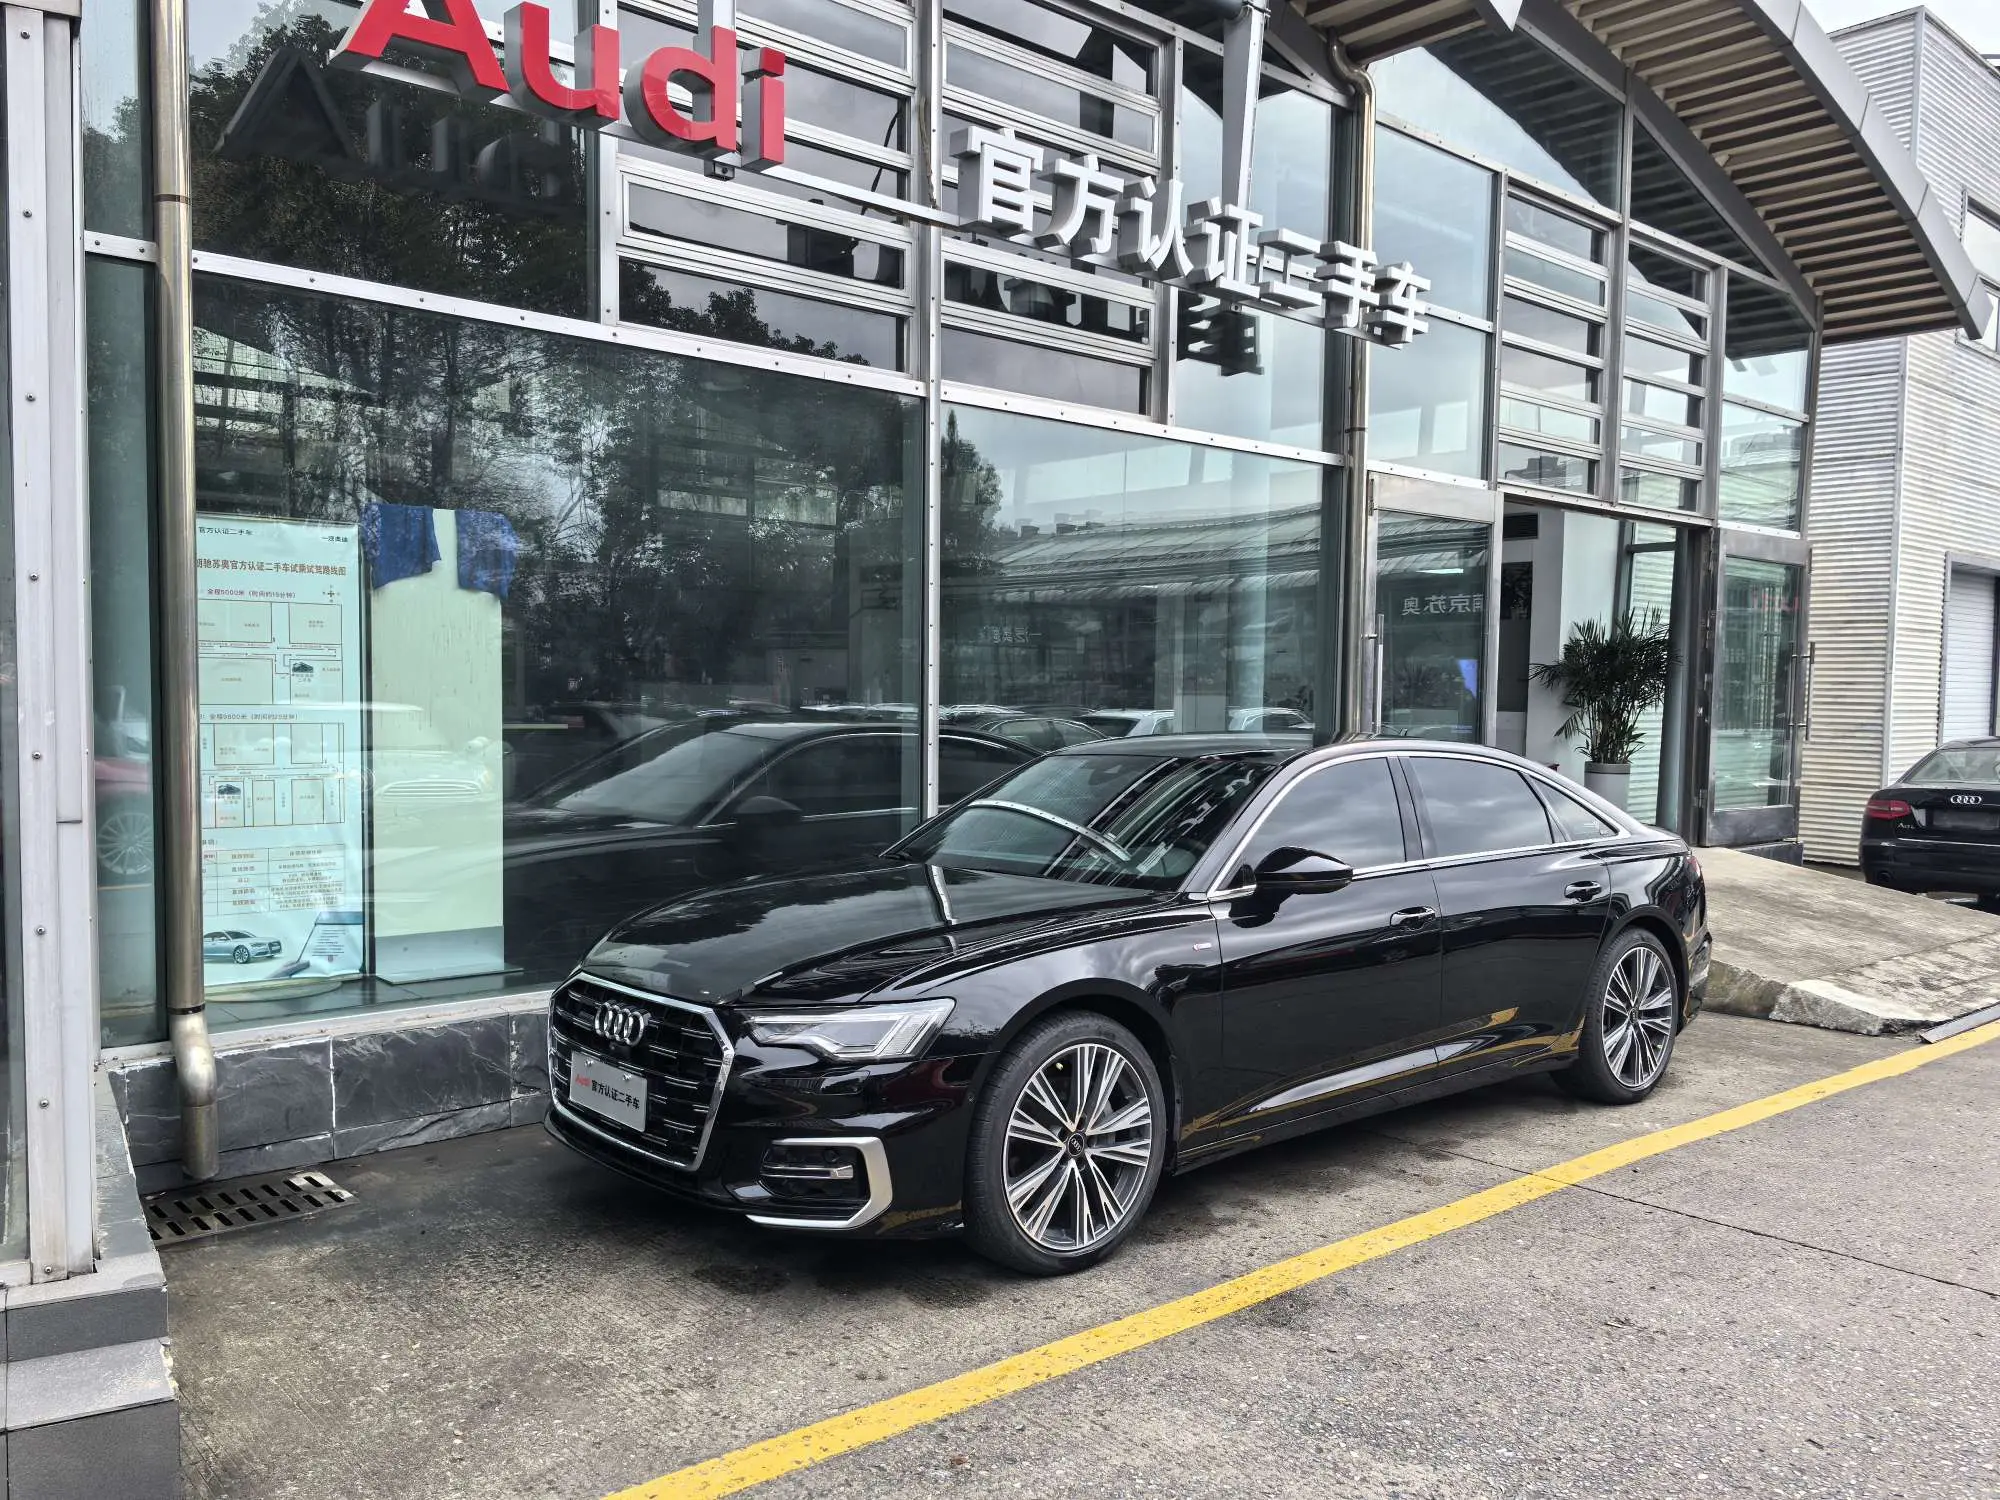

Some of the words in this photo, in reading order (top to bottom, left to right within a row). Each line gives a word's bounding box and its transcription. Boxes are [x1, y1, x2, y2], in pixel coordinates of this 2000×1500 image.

[329, 0, 786, 168] Audi
[950, 127, 1431, 348] 官方认证二手车
[591, 1079, 641, 1110] 官方认证二手车
